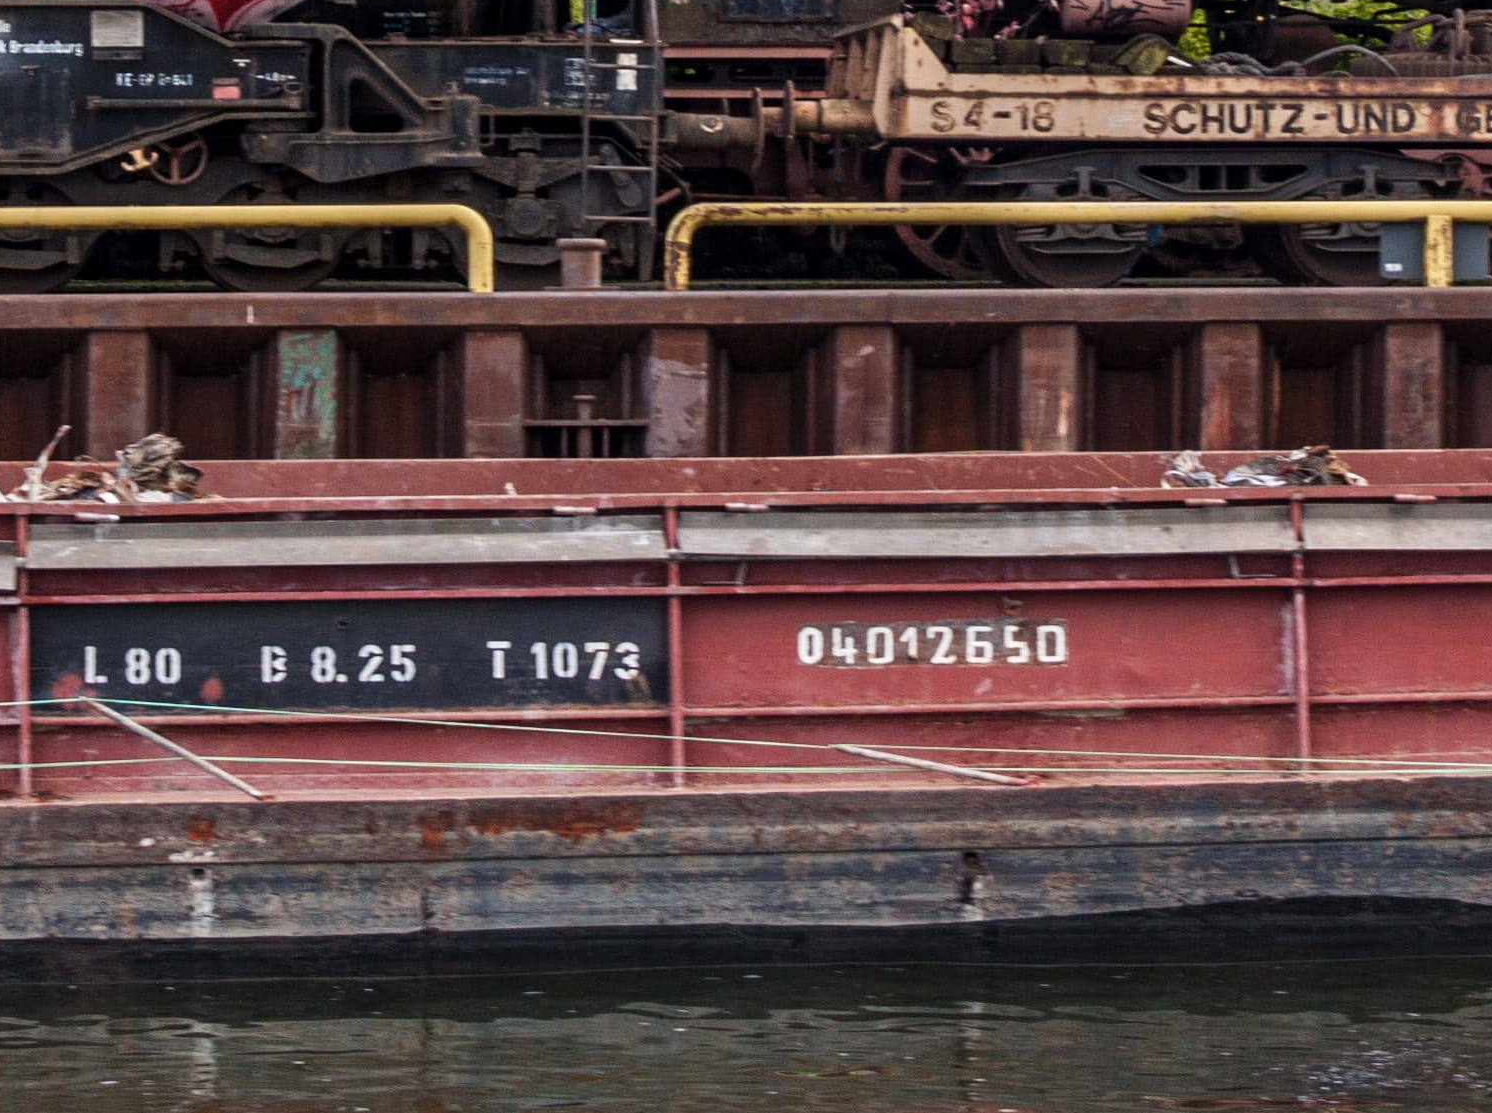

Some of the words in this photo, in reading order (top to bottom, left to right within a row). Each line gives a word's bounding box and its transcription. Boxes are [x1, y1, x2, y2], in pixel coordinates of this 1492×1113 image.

[9, 39, 85, 57] Brandenburg
[84, 645, 108, 684] L
[124, 647, 182, 685] 80
[261, 645, 288, 683] B
[310, 644, 417, 683] 8.25
[486, 641, 512, 679] T
[530, 641, 641, 680] 1073
[796, 625, 1067, 665] 04012650
